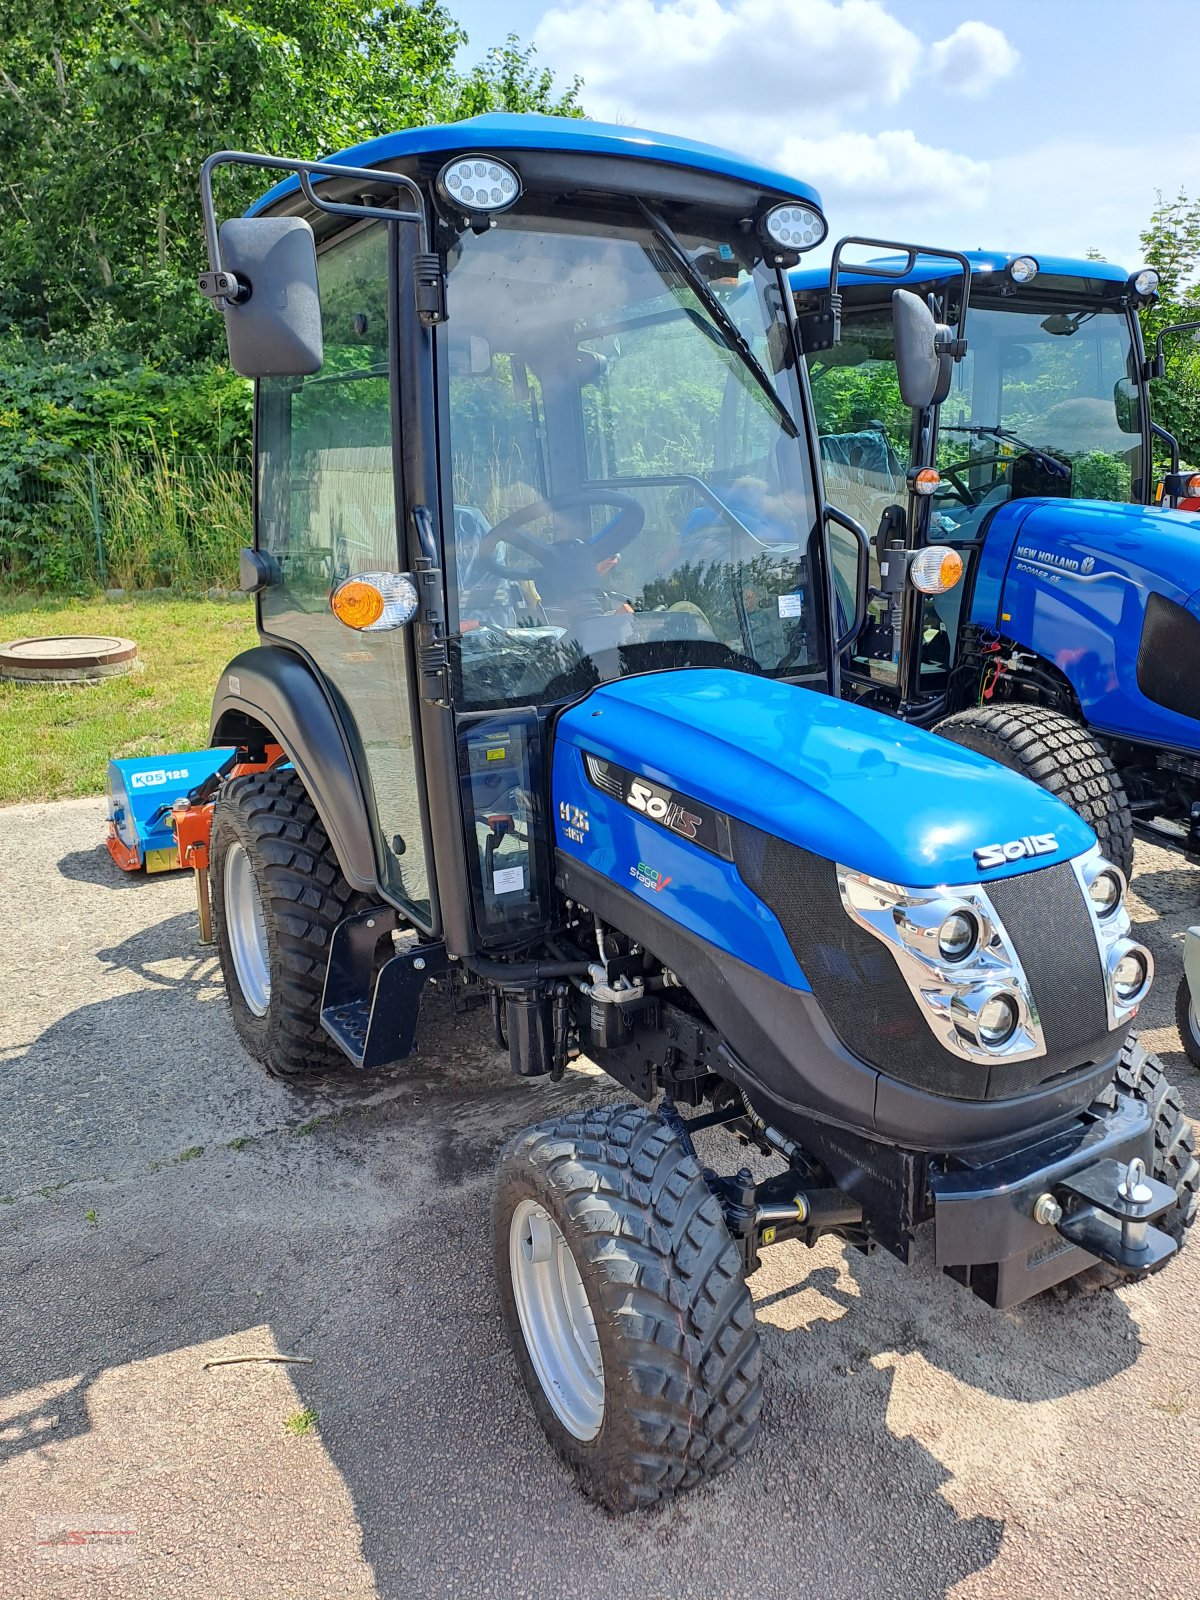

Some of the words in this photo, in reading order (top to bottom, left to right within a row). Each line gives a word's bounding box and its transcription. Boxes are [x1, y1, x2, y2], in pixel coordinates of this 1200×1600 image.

[1016, 546, 1037, 559] NEW
[1038, 550, 1079, 571] HOLLAND
[1016, 563, 1049, 578] BOOMER
[134, 772, 165, 787] KDS
[166, 769, 189, 780] 125
[560, 801, 589, 832] H26
[638, 862, 659, 880] ECO
[656, 873, 672, 892] V
